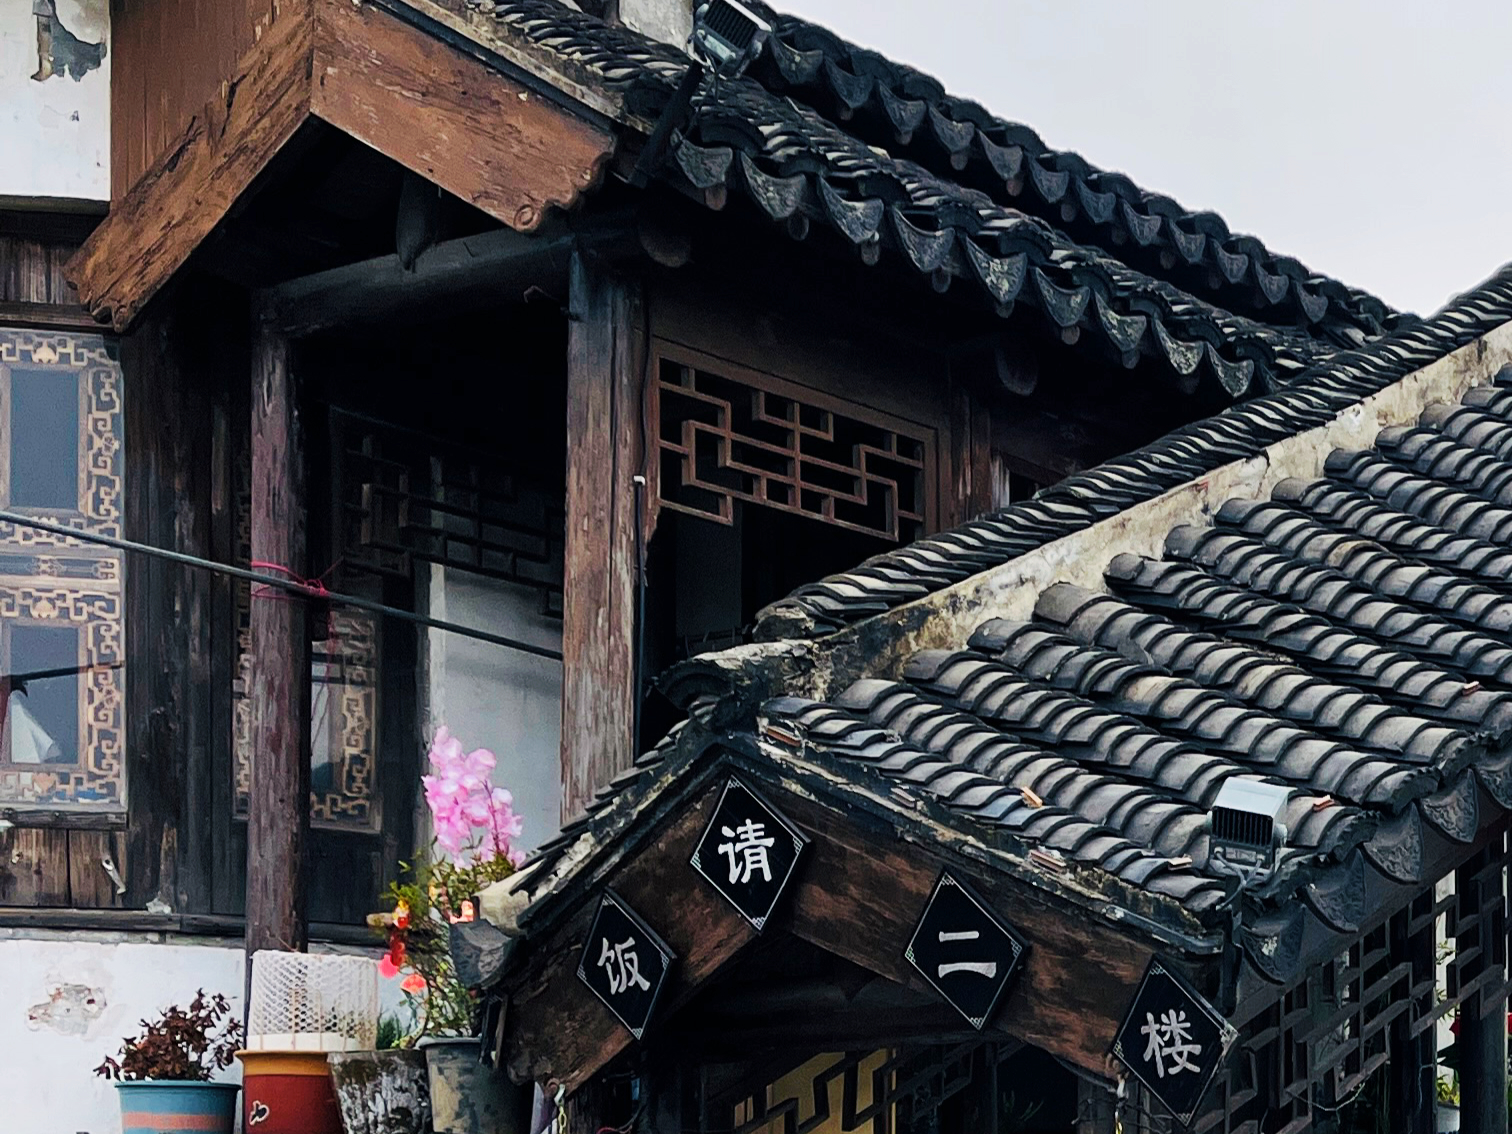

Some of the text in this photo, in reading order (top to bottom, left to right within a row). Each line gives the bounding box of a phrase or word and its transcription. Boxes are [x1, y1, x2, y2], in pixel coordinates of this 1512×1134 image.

[596, 818, 1203, 1079] 饭 请 二 楼
